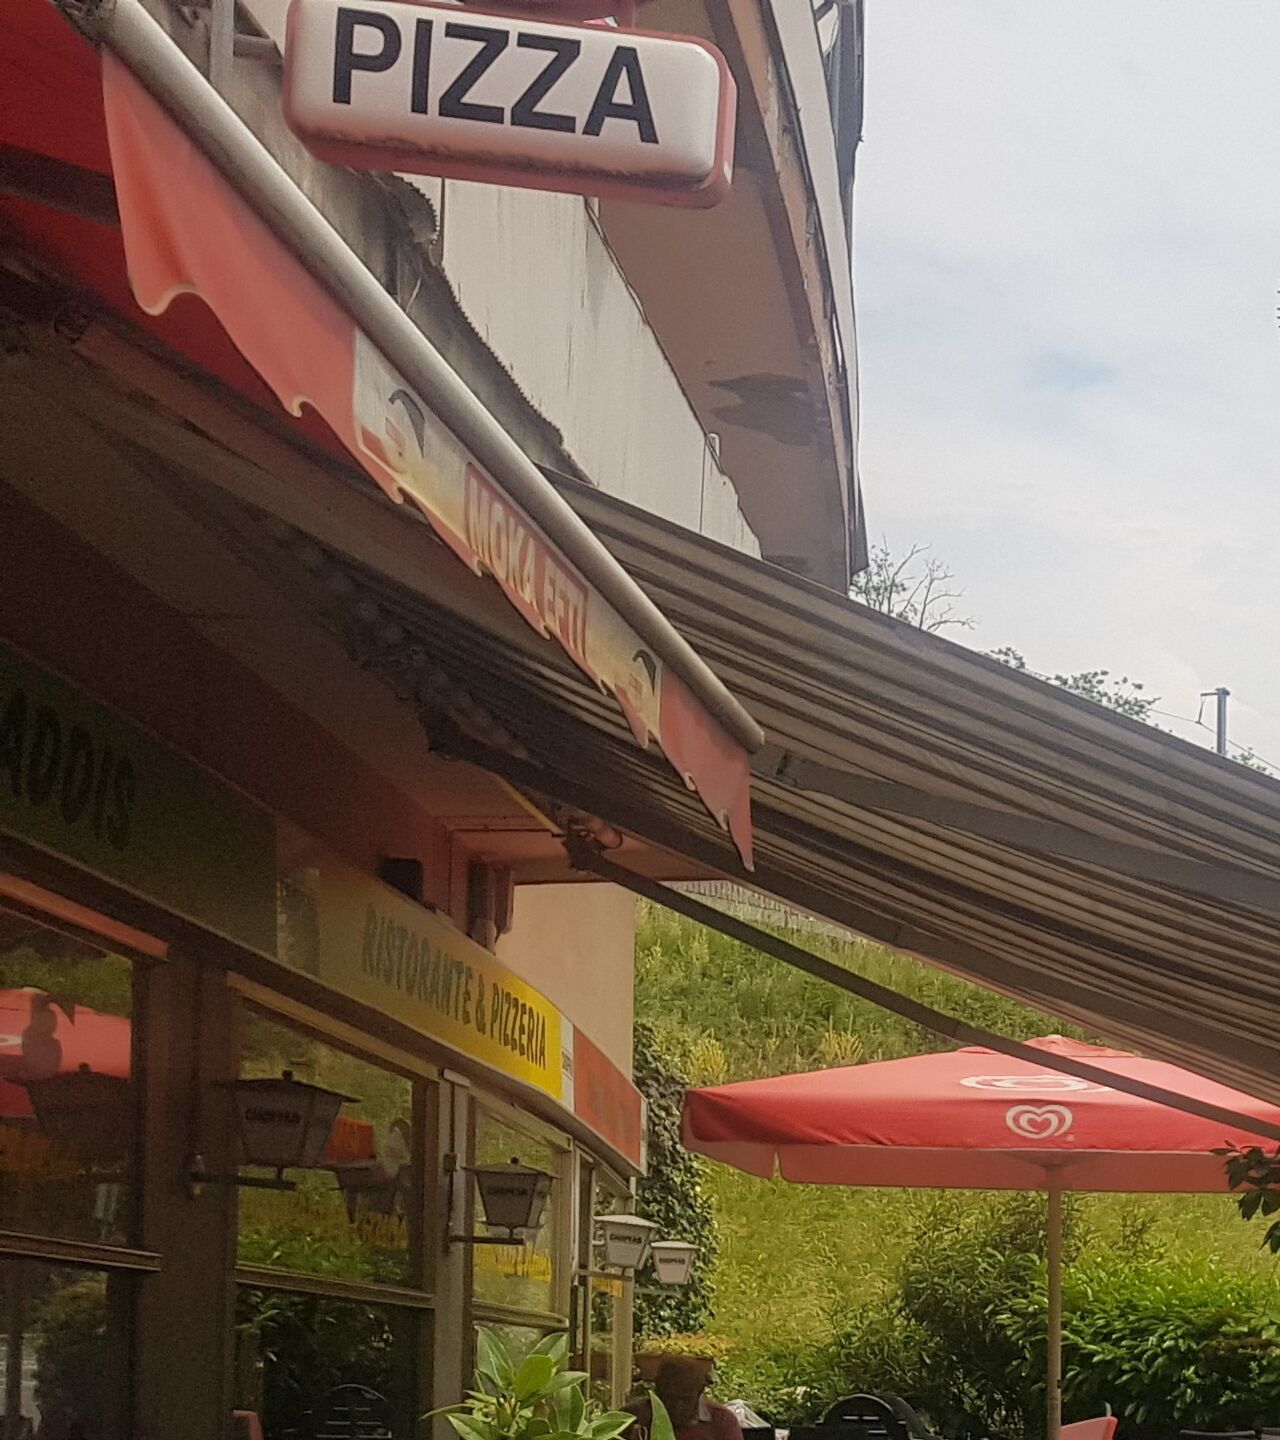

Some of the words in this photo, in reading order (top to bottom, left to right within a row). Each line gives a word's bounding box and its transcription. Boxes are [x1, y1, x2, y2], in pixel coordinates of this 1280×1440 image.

[333, 6, 660, 146] PIZZA
[467, 477, 538, 616] MOKA
[362, 904, 474, 1027] RISTORANTE
[475, 973, 487, 1034] &
[490, 981, 547, 1072] PIZZERIA
